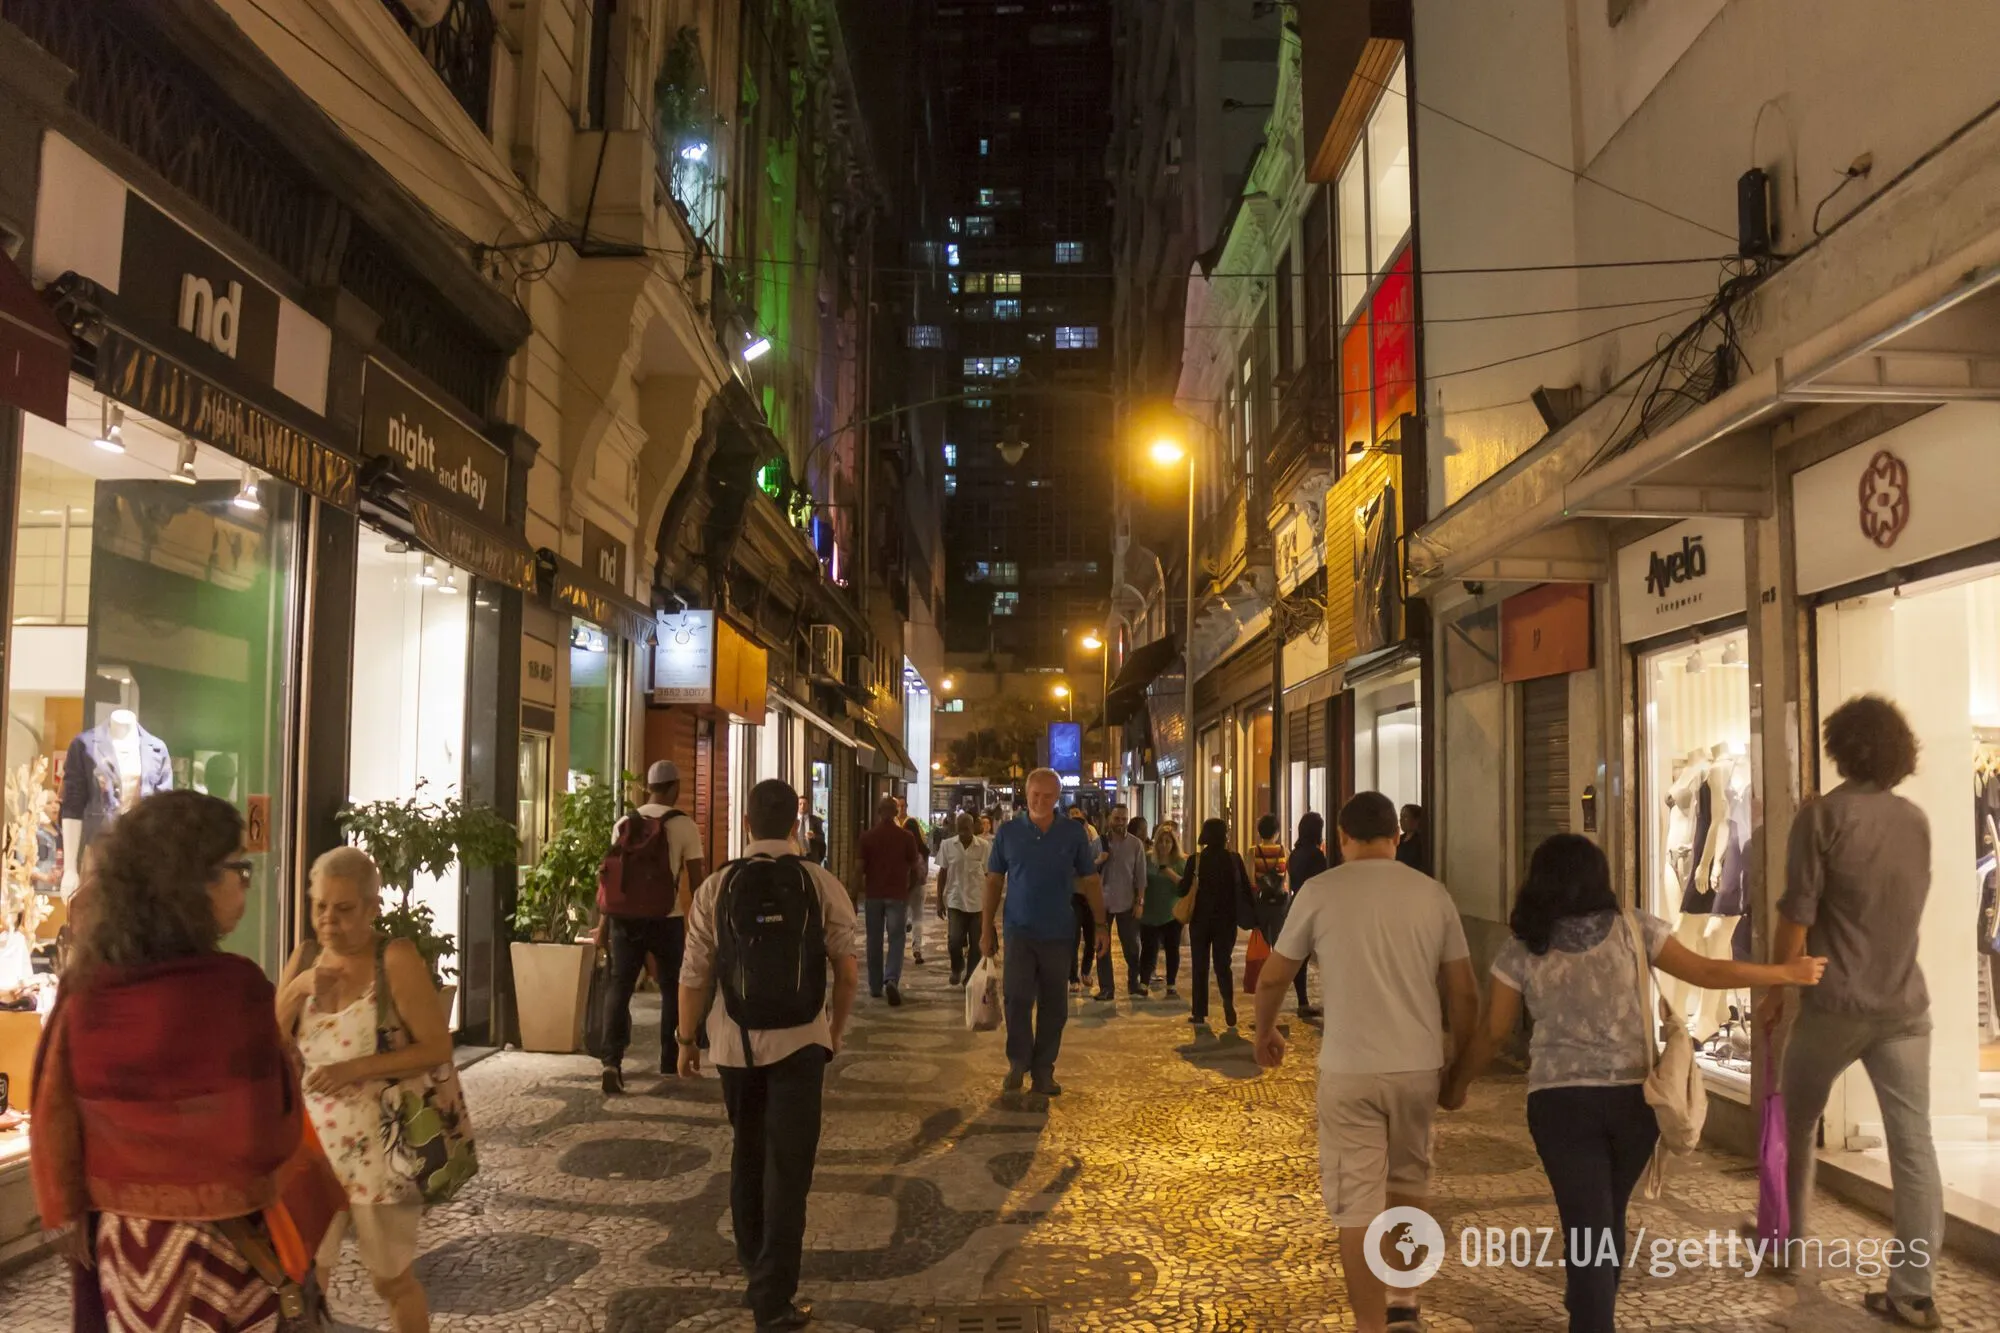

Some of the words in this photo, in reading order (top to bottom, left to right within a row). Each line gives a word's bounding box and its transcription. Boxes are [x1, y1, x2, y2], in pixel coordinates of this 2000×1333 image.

[178, 272, 243, 360] nd
[388, 413, 436, 473] night
[438, 467, 457, 494] and
[461, 456, 487, 511] day
[600, 547, 617, 586] nd
